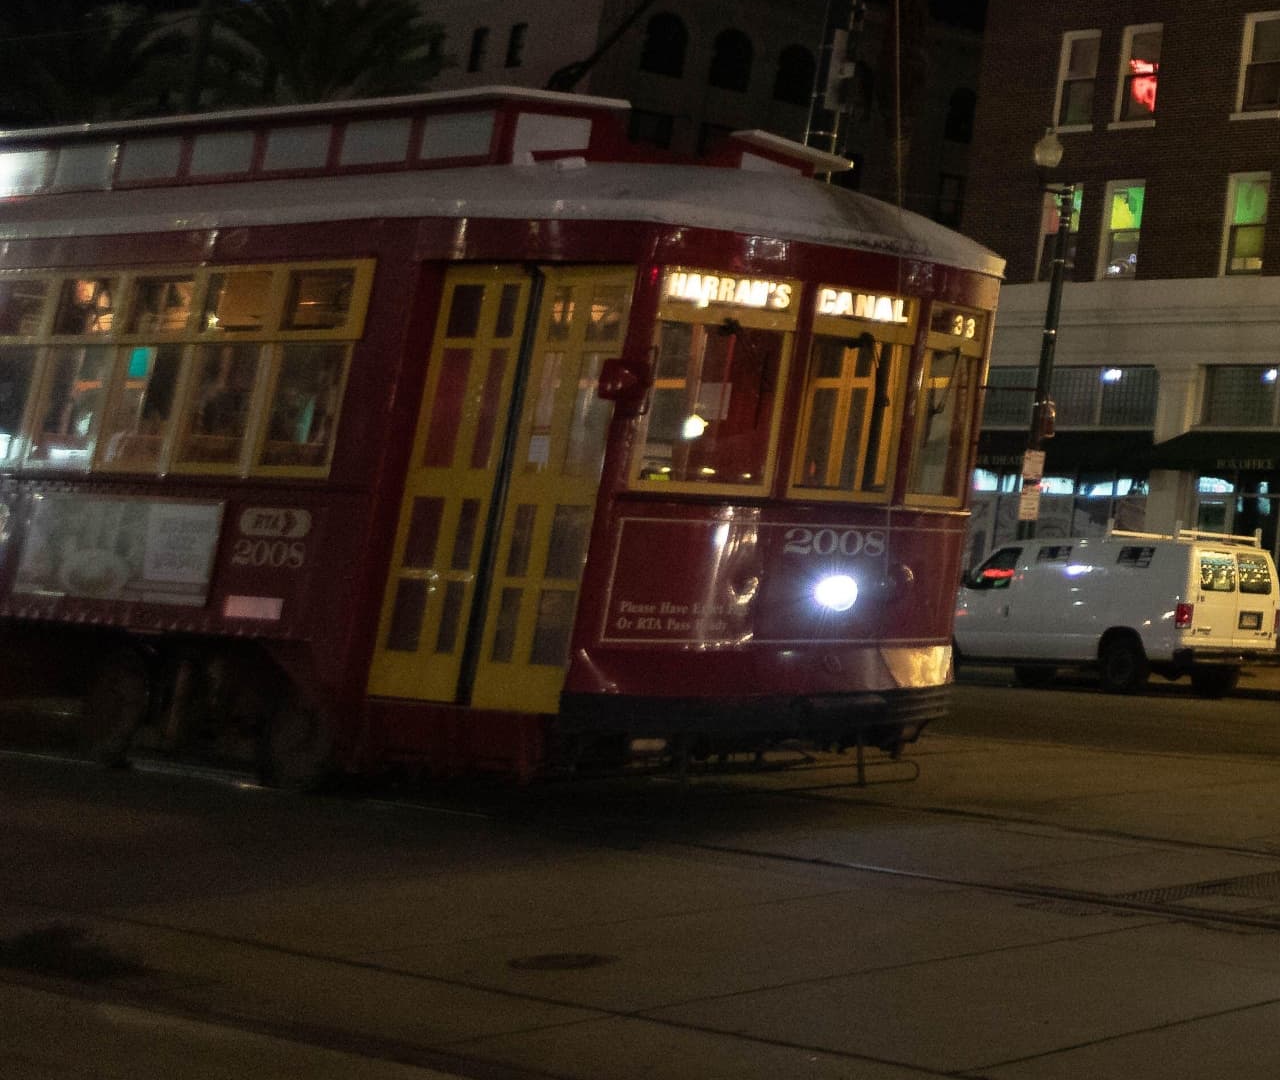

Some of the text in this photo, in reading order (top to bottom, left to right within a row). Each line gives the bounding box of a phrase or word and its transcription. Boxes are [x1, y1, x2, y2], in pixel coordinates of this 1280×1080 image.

[818, 288, 908, 322] CANAL
[953, 315, 976, 338] 33
[1240, 457, 1275, 470] OFFICE
[232, 539, 305, 569] 2008
[785, 528, 886, 557] 2008
[620, 601, 656, 614] Please
[660, 601, 688, 614] Have
[617, 617, 634, 630] Or
[637, 617, 662, 630] RTA
[667, 618, 691, 631] Pass
